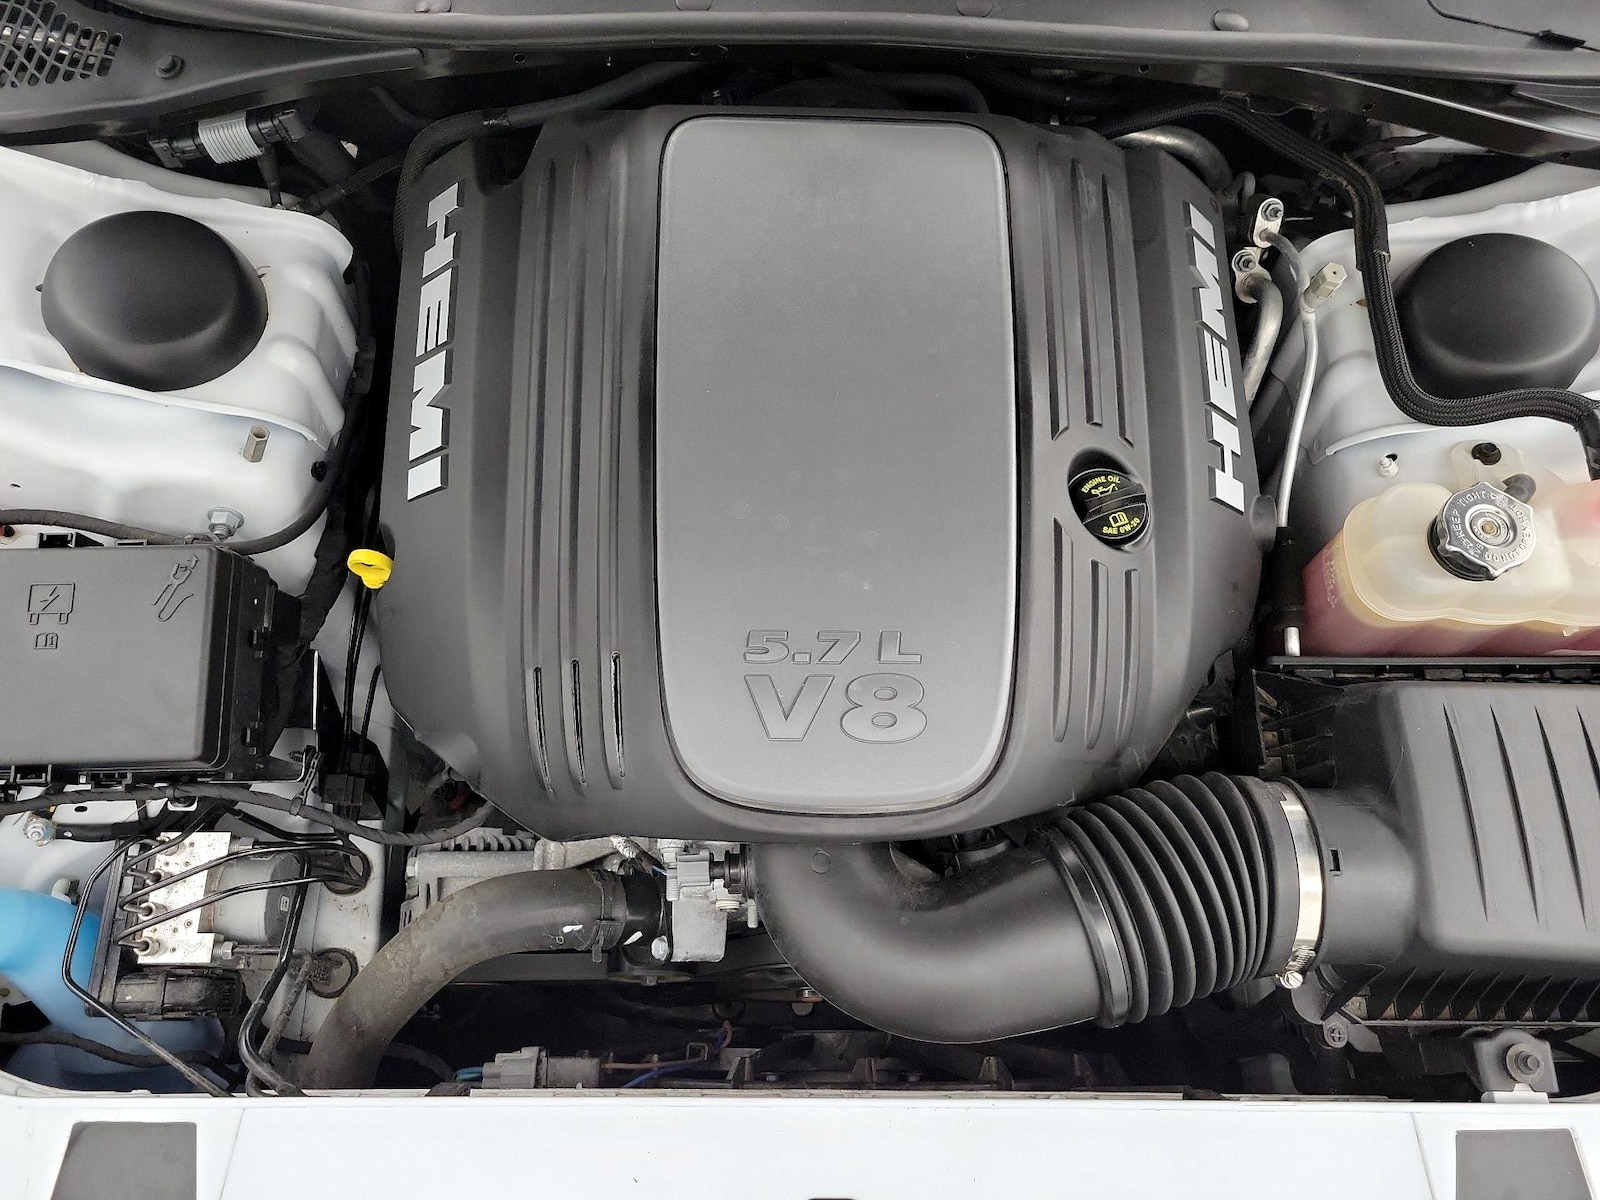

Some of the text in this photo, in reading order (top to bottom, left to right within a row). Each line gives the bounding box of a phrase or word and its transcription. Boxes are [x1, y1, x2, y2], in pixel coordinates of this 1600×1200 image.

[407, 182, 459, 501] HEMI
[1189, 203, 1245, 514] HEMI
[1081, 475, 1121, 493] ENGINE OIL
[1102, 517, 1141, 535] SAE 0W-20
[1450, 509, 1465, 539] KEEP
[743, 629, 922, 665] 5.7 L
[744, 672, 928, 744] V8
